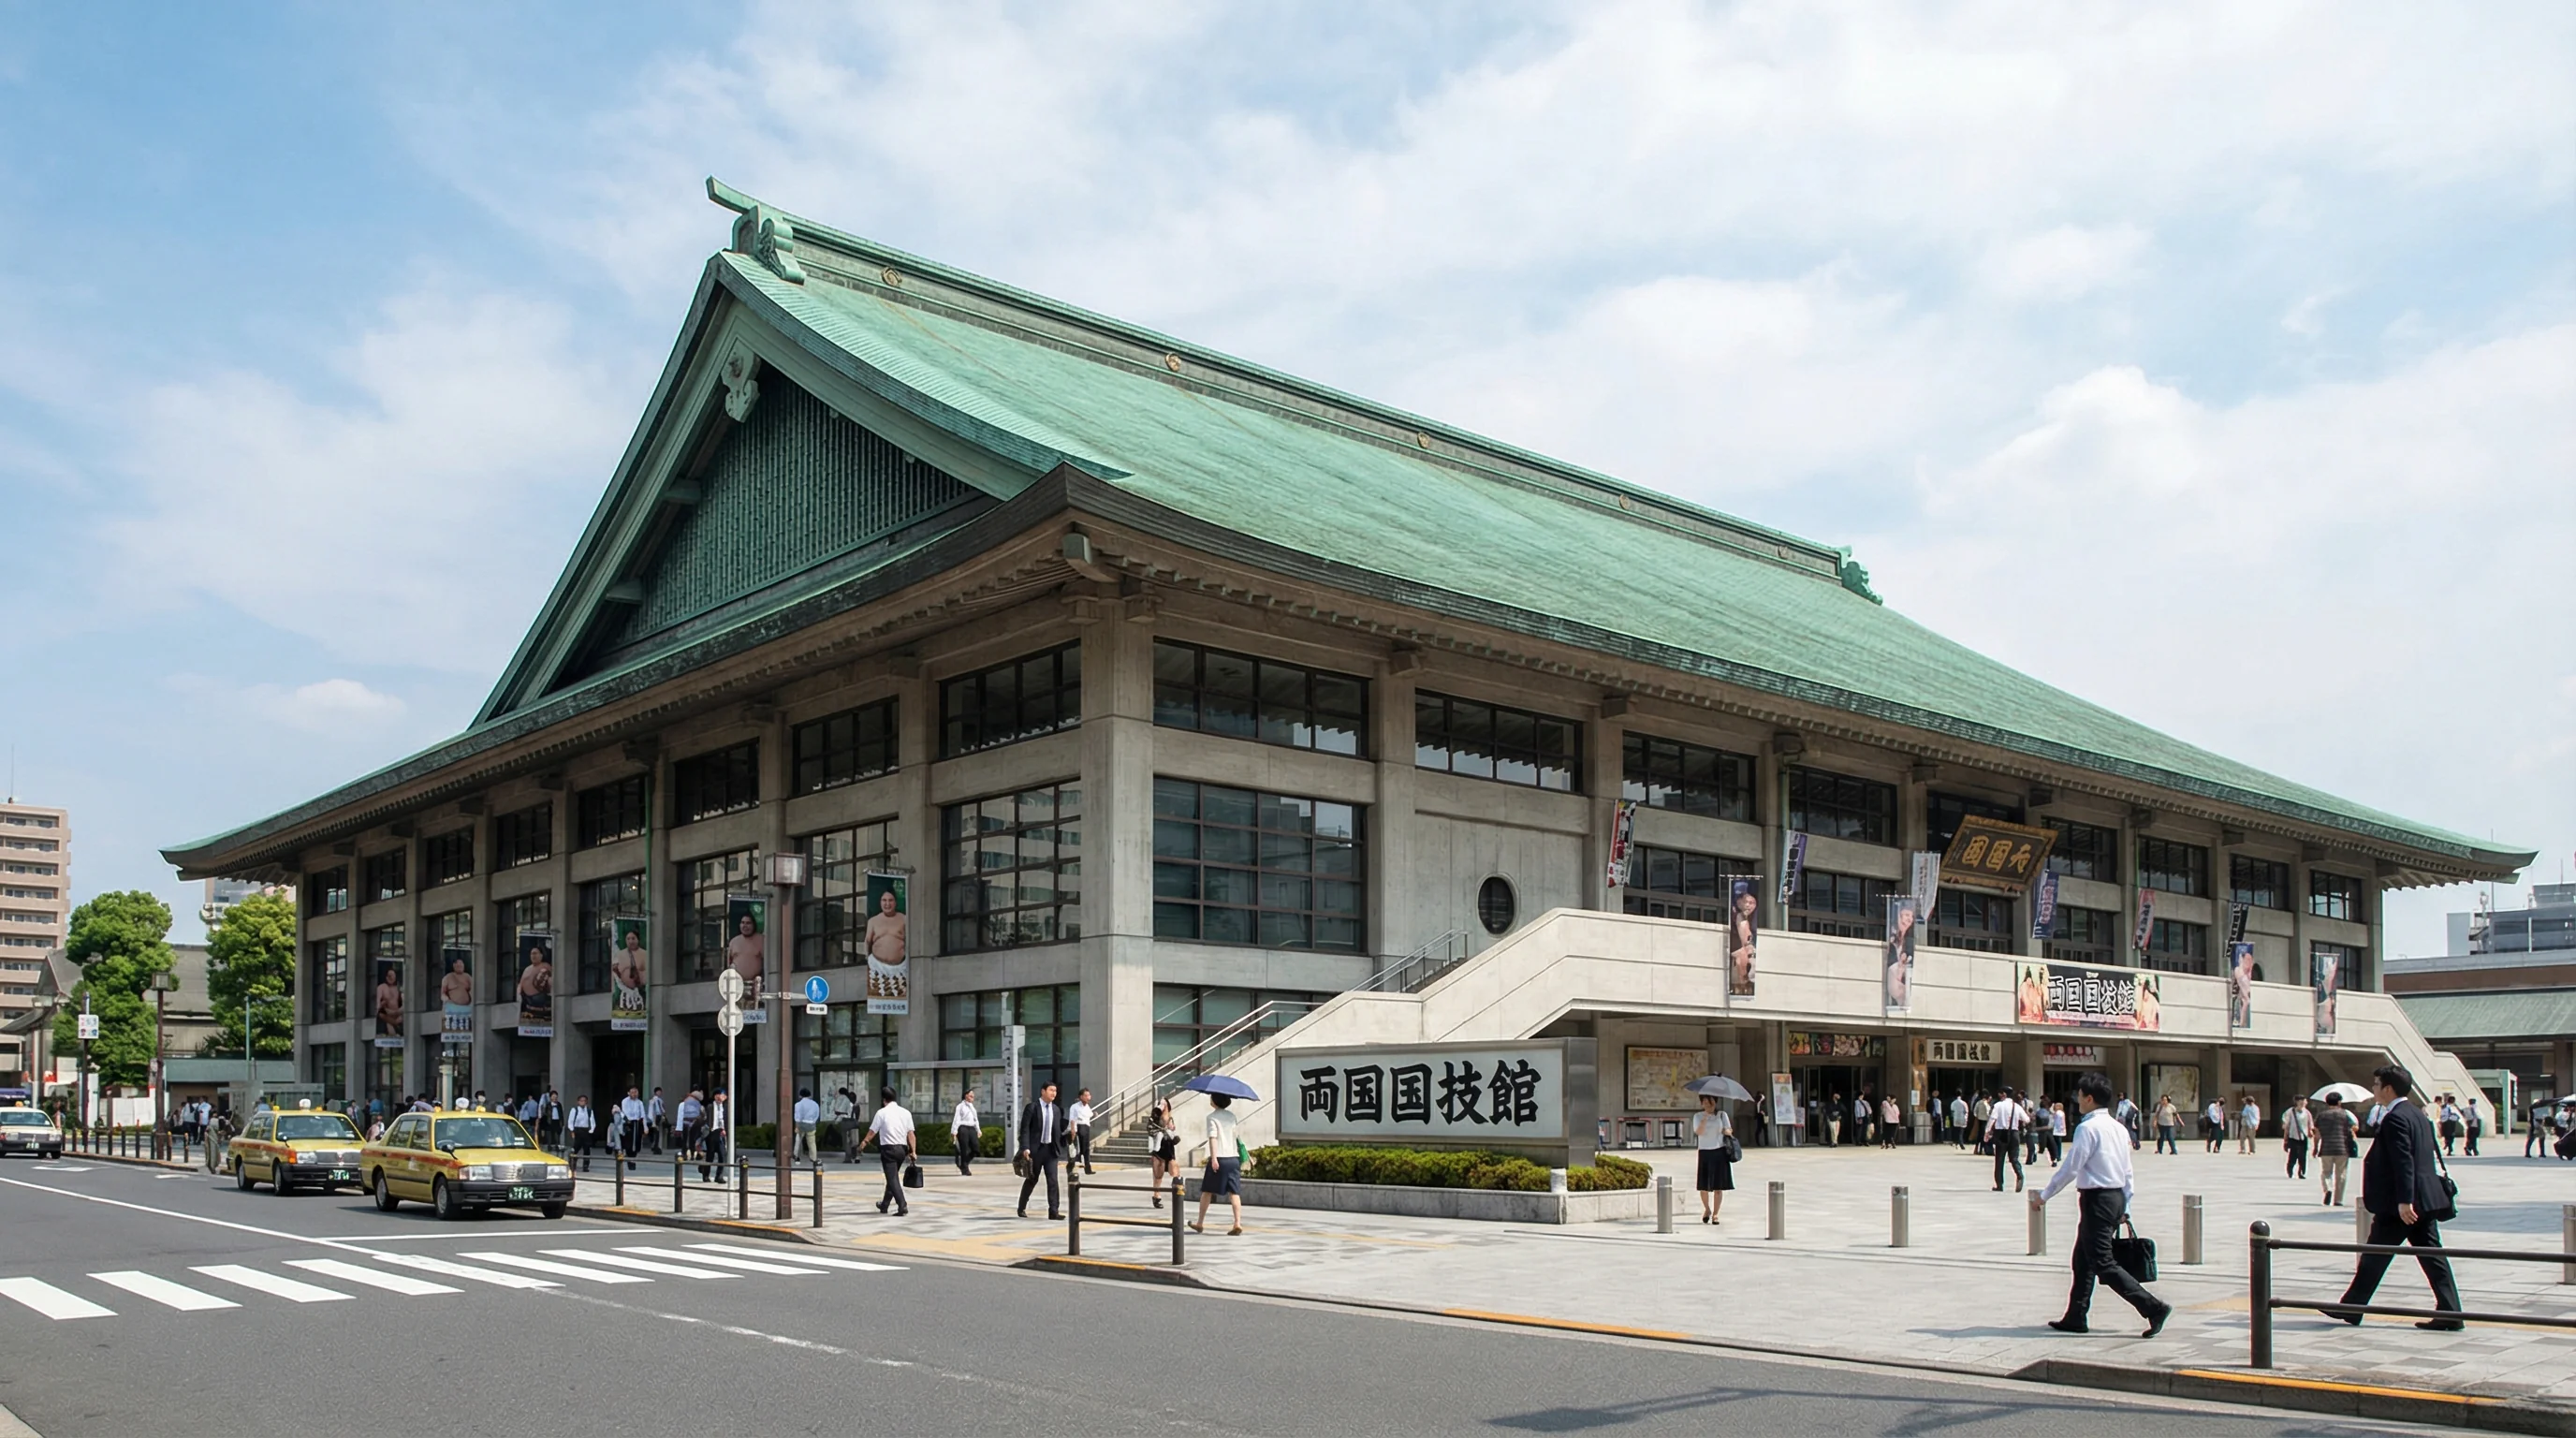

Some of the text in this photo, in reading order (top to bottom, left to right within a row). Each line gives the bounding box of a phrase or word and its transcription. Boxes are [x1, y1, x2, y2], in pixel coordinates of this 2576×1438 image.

[1298, 1058, 1543, 1127] 両国国技館
